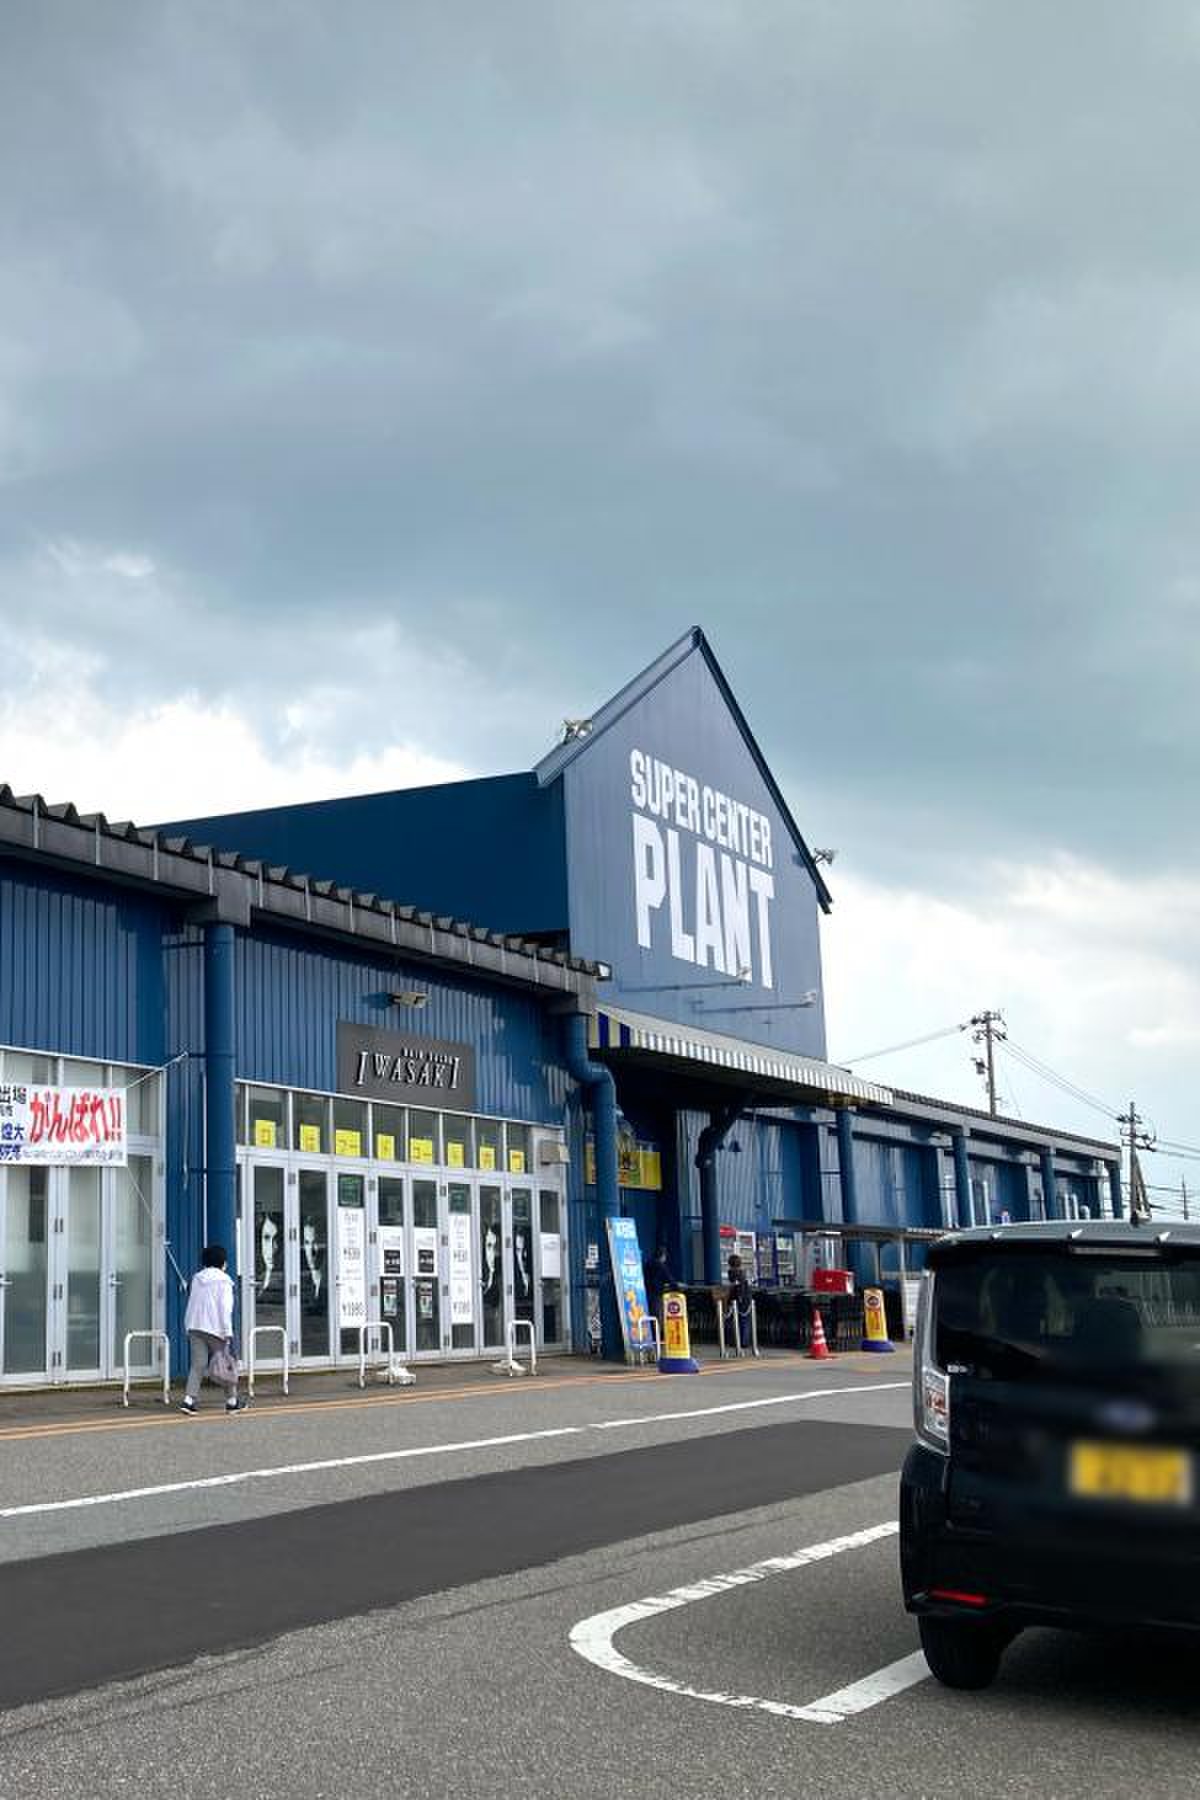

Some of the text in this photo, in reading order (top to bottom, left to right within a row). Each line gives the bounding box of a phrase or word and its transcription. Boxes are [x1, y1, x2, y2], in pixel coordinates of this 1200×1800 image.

[630, 749, 773, 869] SUPER CENTER
[632, 812, 775, 989] PLANT
[357, 1051, 460, 1088] IWASAKI
